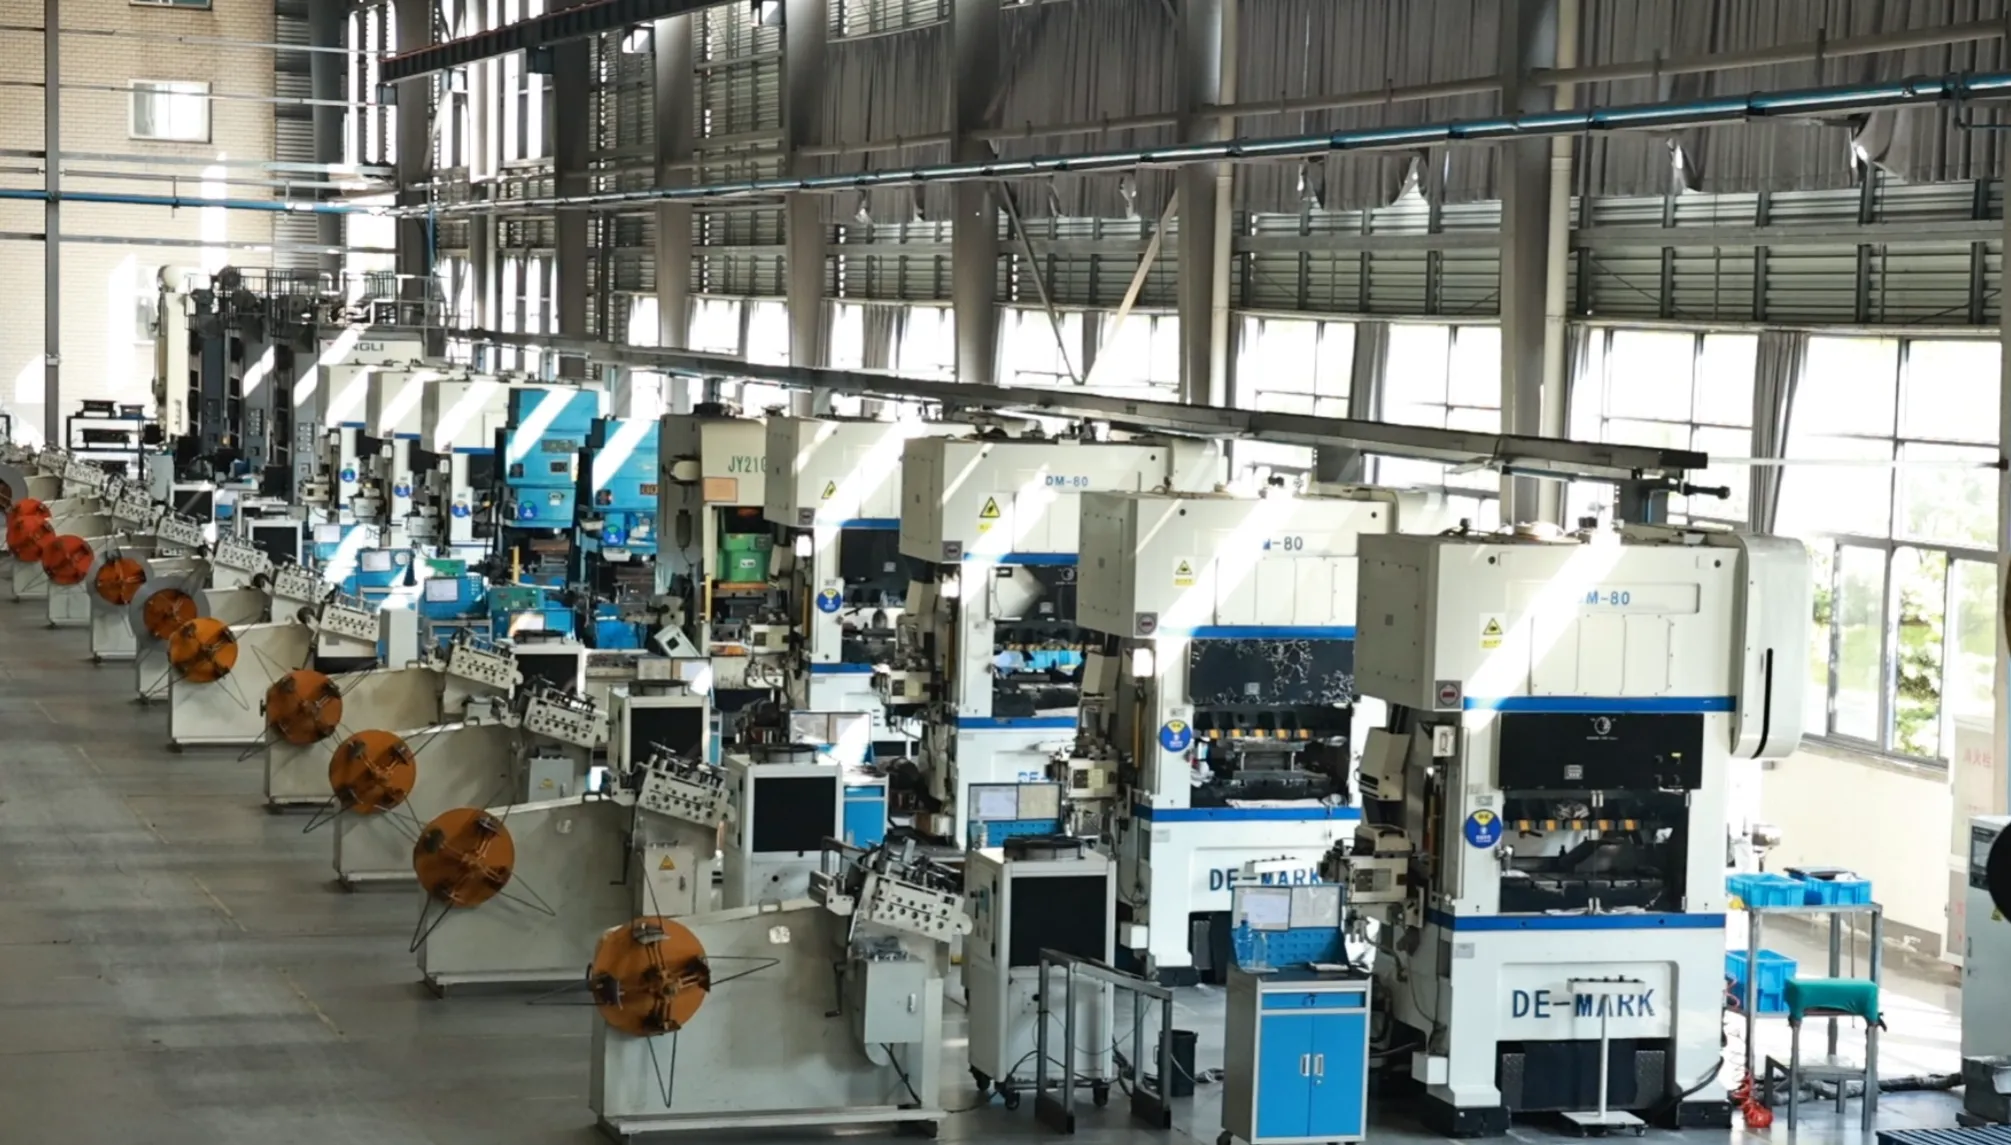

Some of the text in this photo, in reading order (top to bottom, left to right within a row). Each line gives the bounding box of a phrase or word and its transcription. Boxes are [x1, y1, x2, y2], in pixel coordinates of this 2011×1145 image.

[1045, 475, 1089, 488] DM-80
[1580, 590, 1630, 606] M-80
[1512, 988, 1655, 1018] DE-MARK
